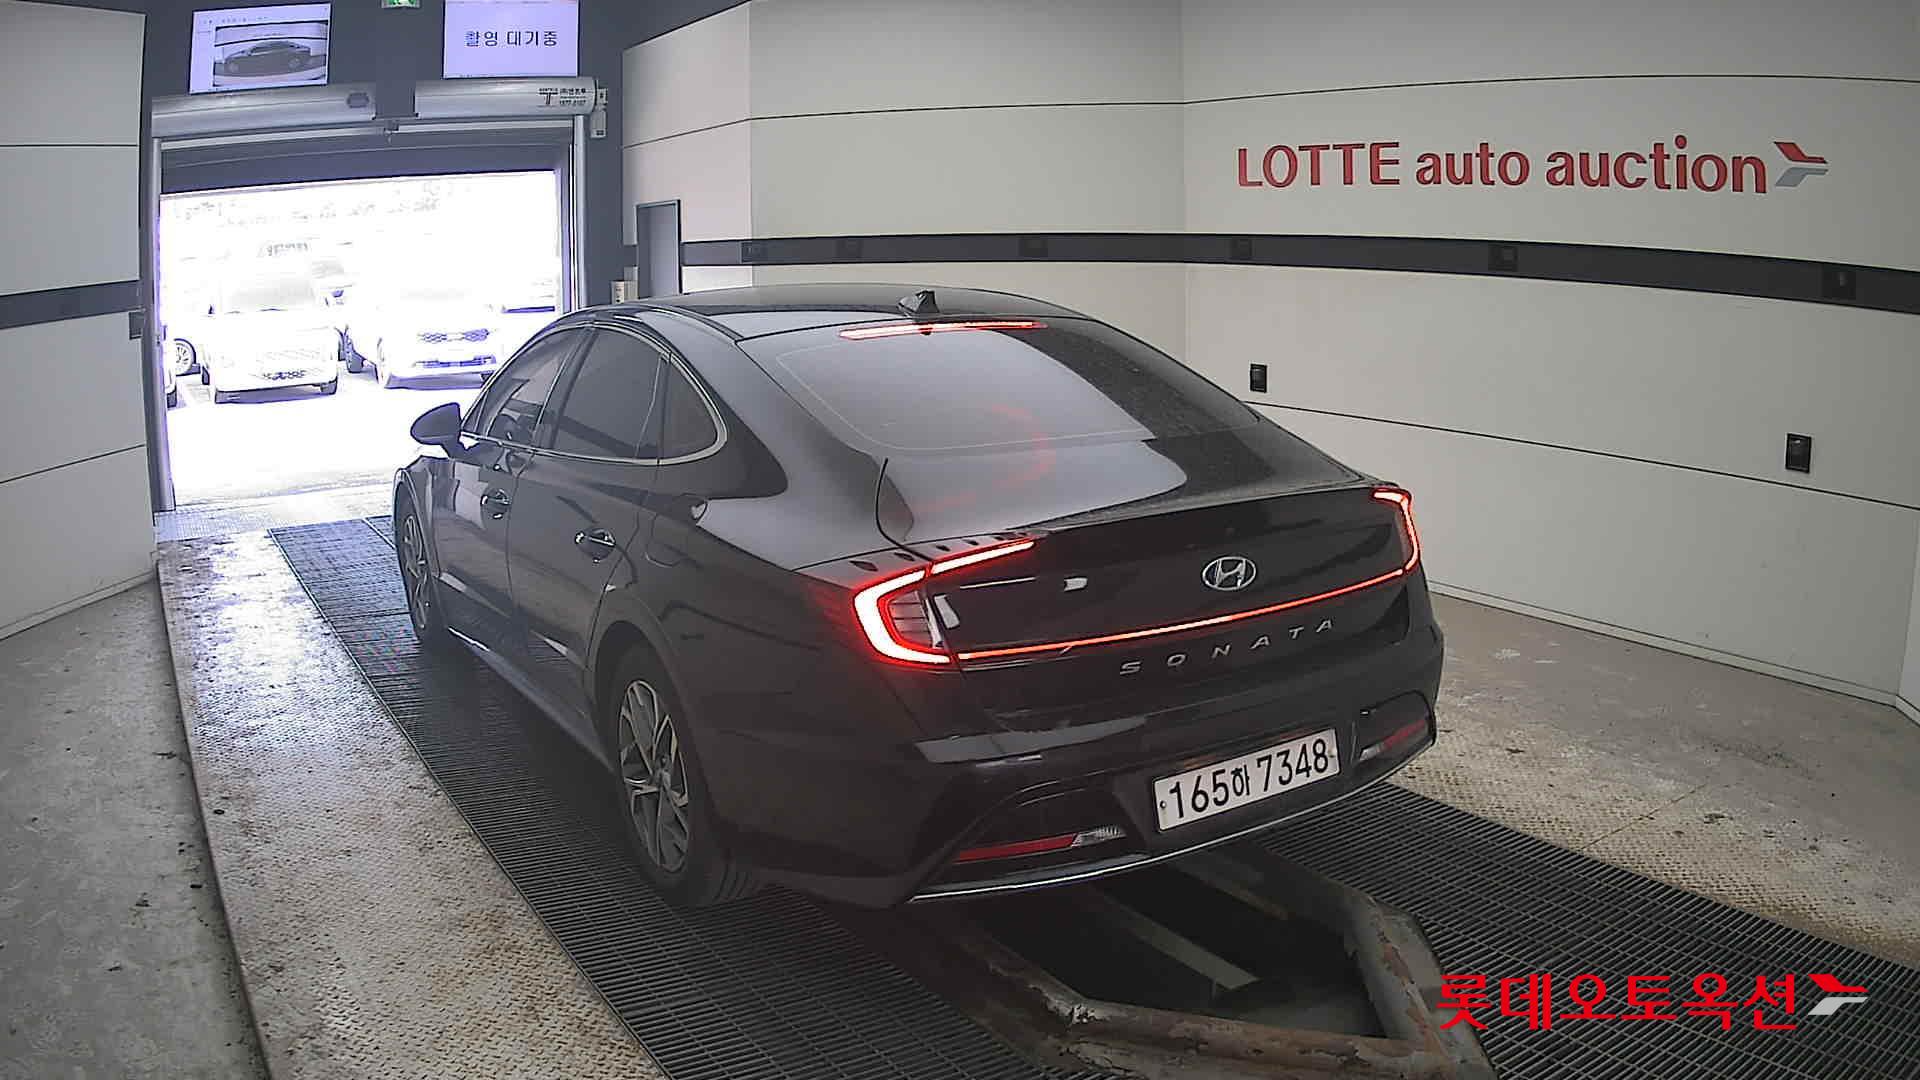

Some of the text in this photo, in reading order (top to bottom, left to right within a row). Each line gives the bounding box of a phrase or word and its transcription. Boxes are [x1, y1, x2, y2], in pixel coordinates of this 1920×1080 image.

[1237, 134, 1767, 193] LOTTE auto auction
[1119, 618, 1334, 675] SONATA
